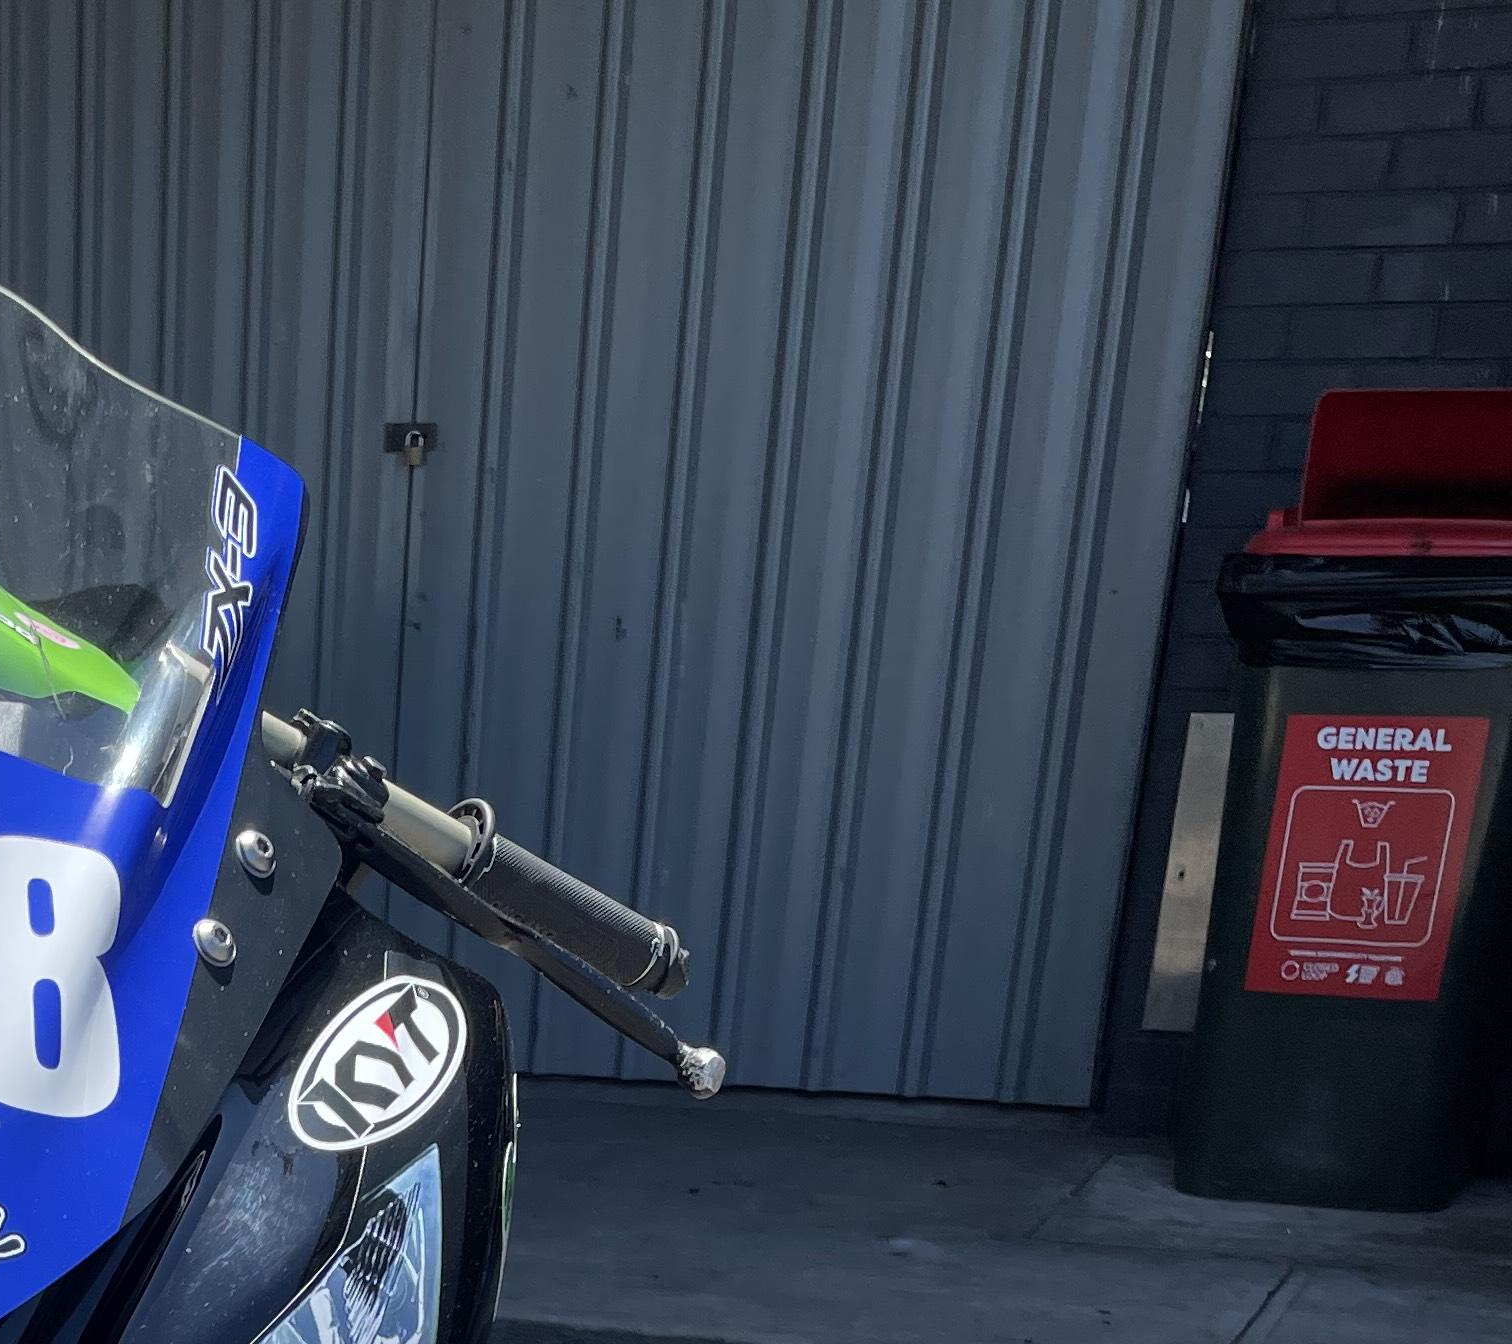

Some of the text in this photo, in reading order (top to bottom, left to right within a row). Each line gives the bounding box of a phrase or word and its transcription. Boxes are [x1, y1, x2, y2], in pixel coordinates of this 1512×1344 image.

[1316, 725, 1453, 752] GENERAL
[1329, 757, 1431, 783] WASTE
[298, 982, 441, 1140] KYT
